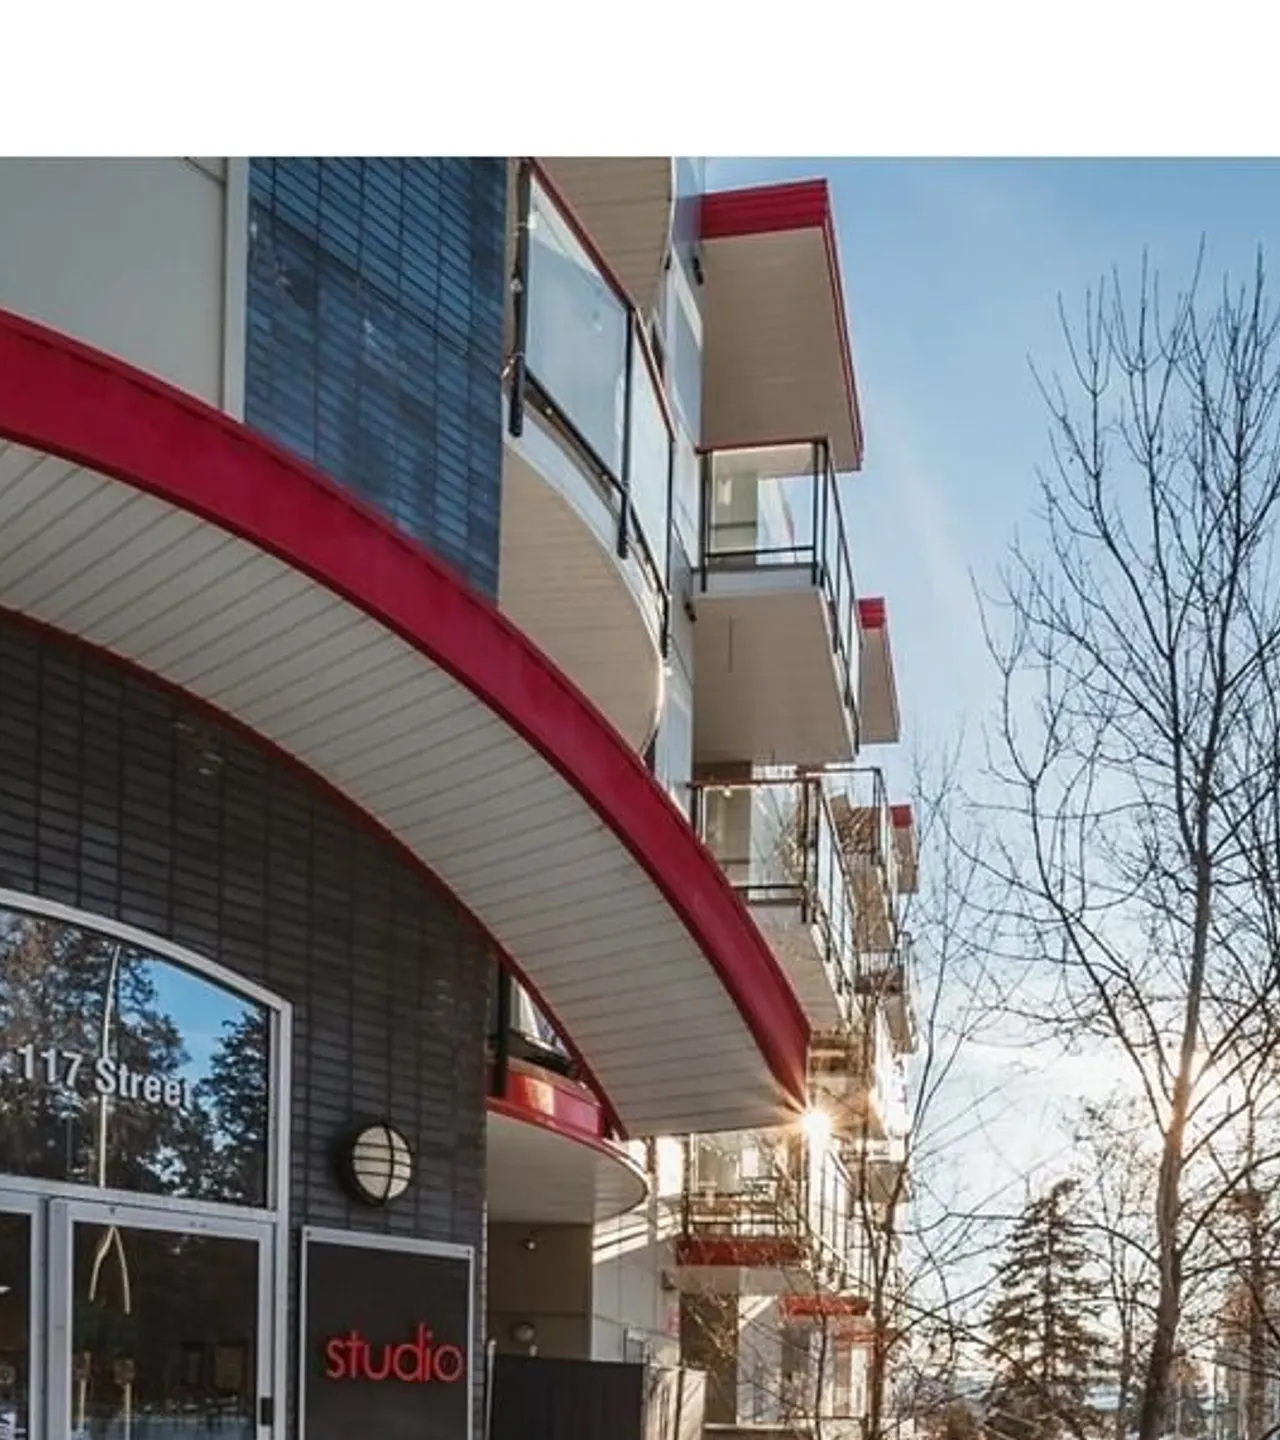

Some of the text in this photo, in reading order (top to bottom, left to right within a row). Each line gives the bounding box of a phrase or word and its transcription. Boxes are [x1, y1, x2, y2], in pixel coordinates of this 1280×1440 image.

[18, 1043, 83, 1088] 117
[94, 1056, 193, 1109] Street
[325, 1320, 464, 1382] studio
